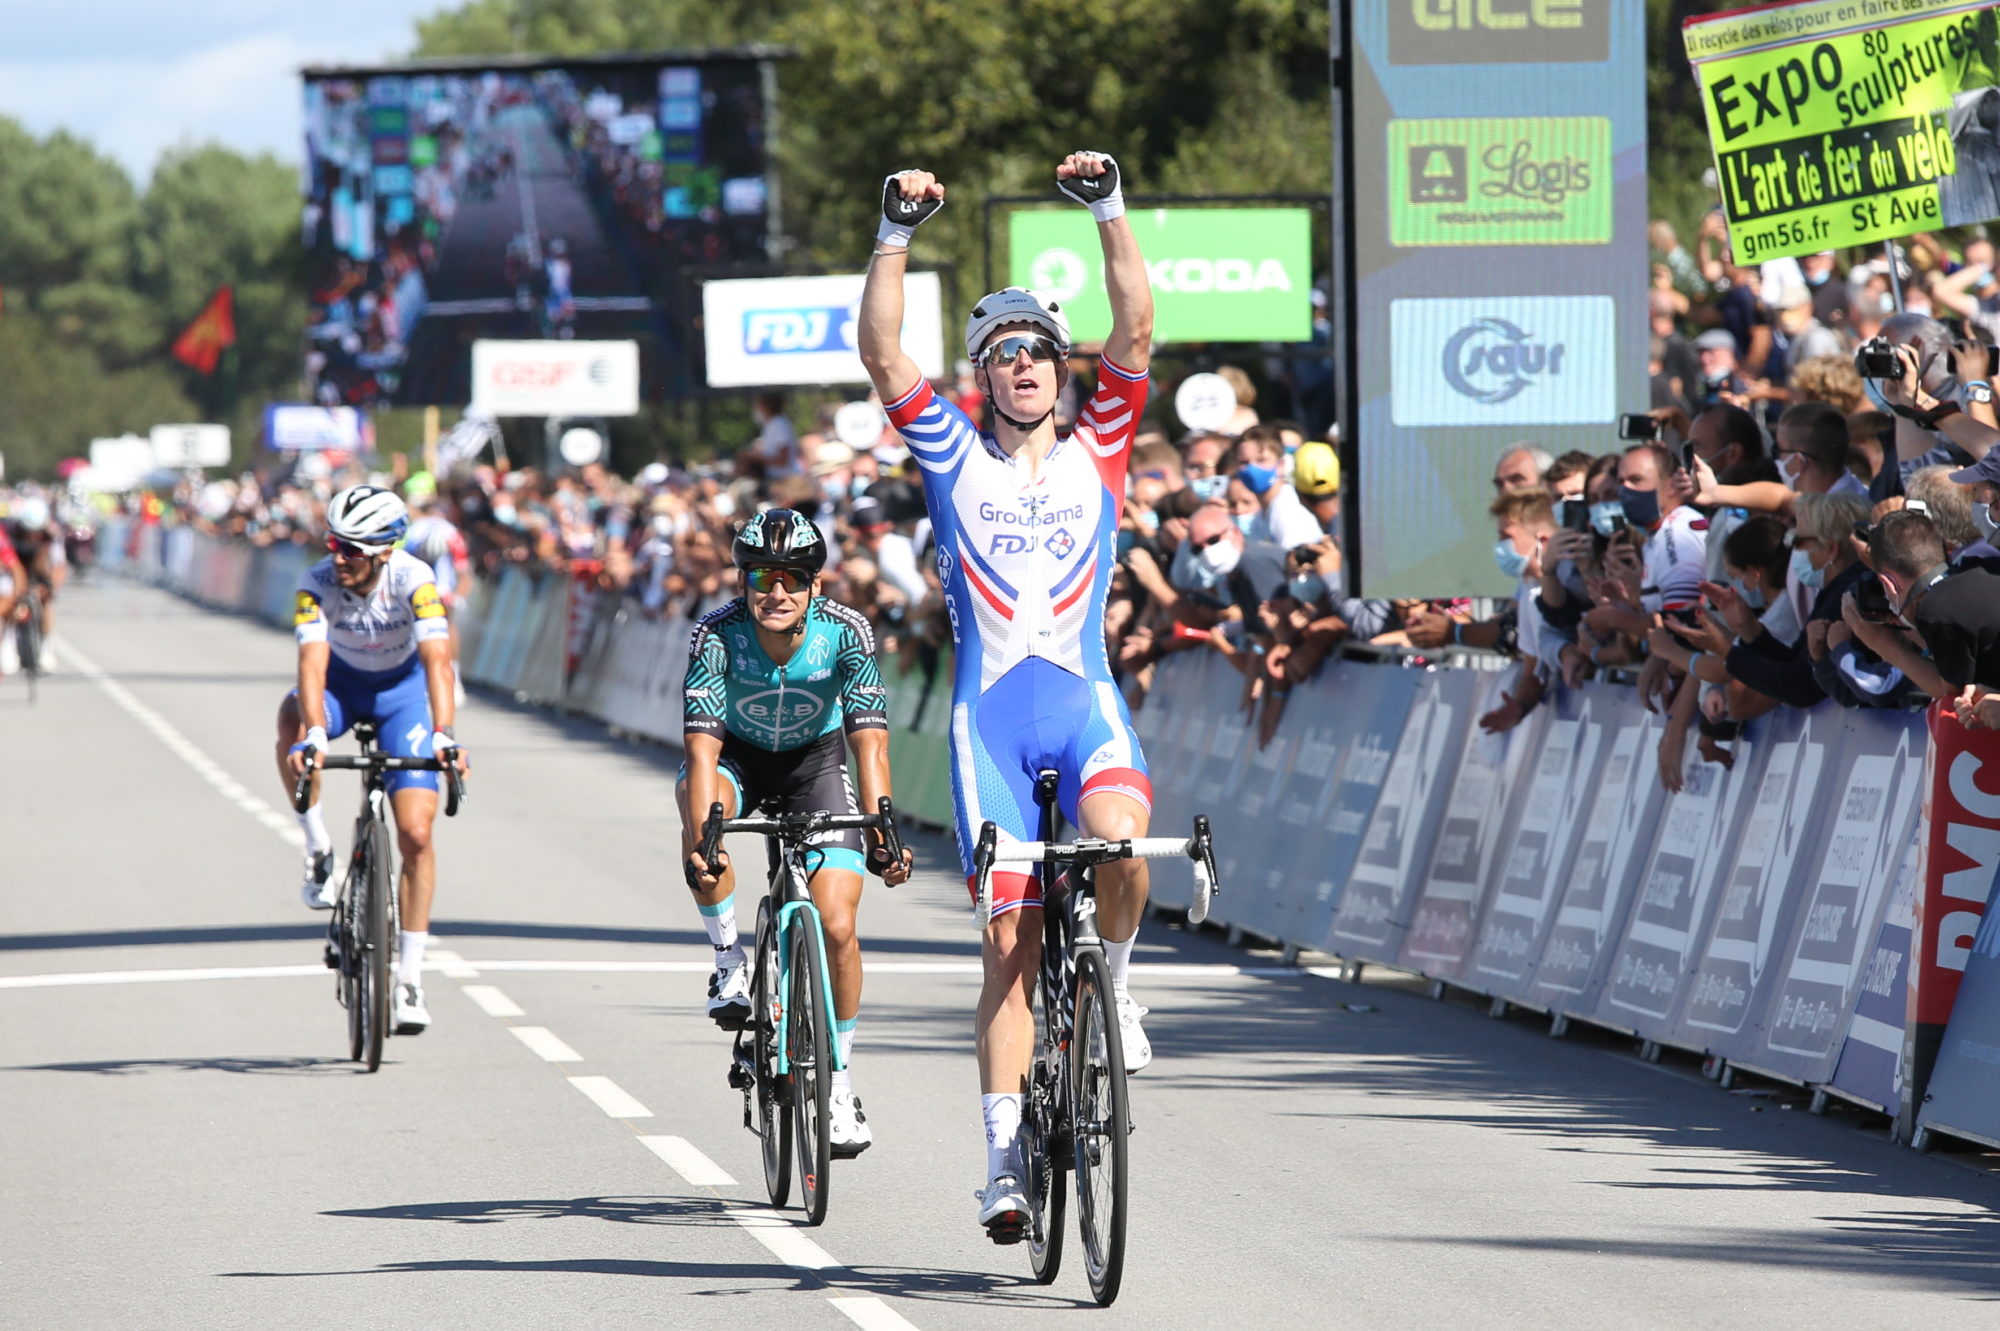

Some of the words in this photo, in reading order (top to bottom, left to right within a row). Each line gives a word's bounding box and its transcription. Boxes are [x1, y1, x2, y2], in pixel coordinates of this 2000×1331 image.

[1700, 28, 1739, 50] recycle
[1742, 22, 1761, 41] des
[1762, 16, 1793, 36] vélos
[1795, 10, 1831, 33] pour
[1838, 6, 1857, 21] en
[1860, 0, 1899, 17] faire
[1863, 30, 1889, 57] 80
[1710, 43, 1843, 142] Expo
[1835, 15, 1978, 127] sculptures
[1479, 139, 1591, 204] Logis
[1727, 149, 1793, 217] L'art
[1796, 154, 1823, 204] de
[1823, 134, 1863, 197] fer
[1869, 140, 1897, 189] du
[1897, 113, 1957, 183] vélo
[1852, 202, 1880, 232] St
[1890, 188, 1937, 225] Avé
[1744, 215, 1830, 258] gm56.fr
[1101, 258, 1292, 293] KODA
[747, 312, 830, 351] FDJ
[979, 502, 1083, 527] Groupama
[827, 599, 876, 653] SYNERGIE
[685, 720, 711, 728] TAGNE
[855, 717, 888, 725] BRETAG
